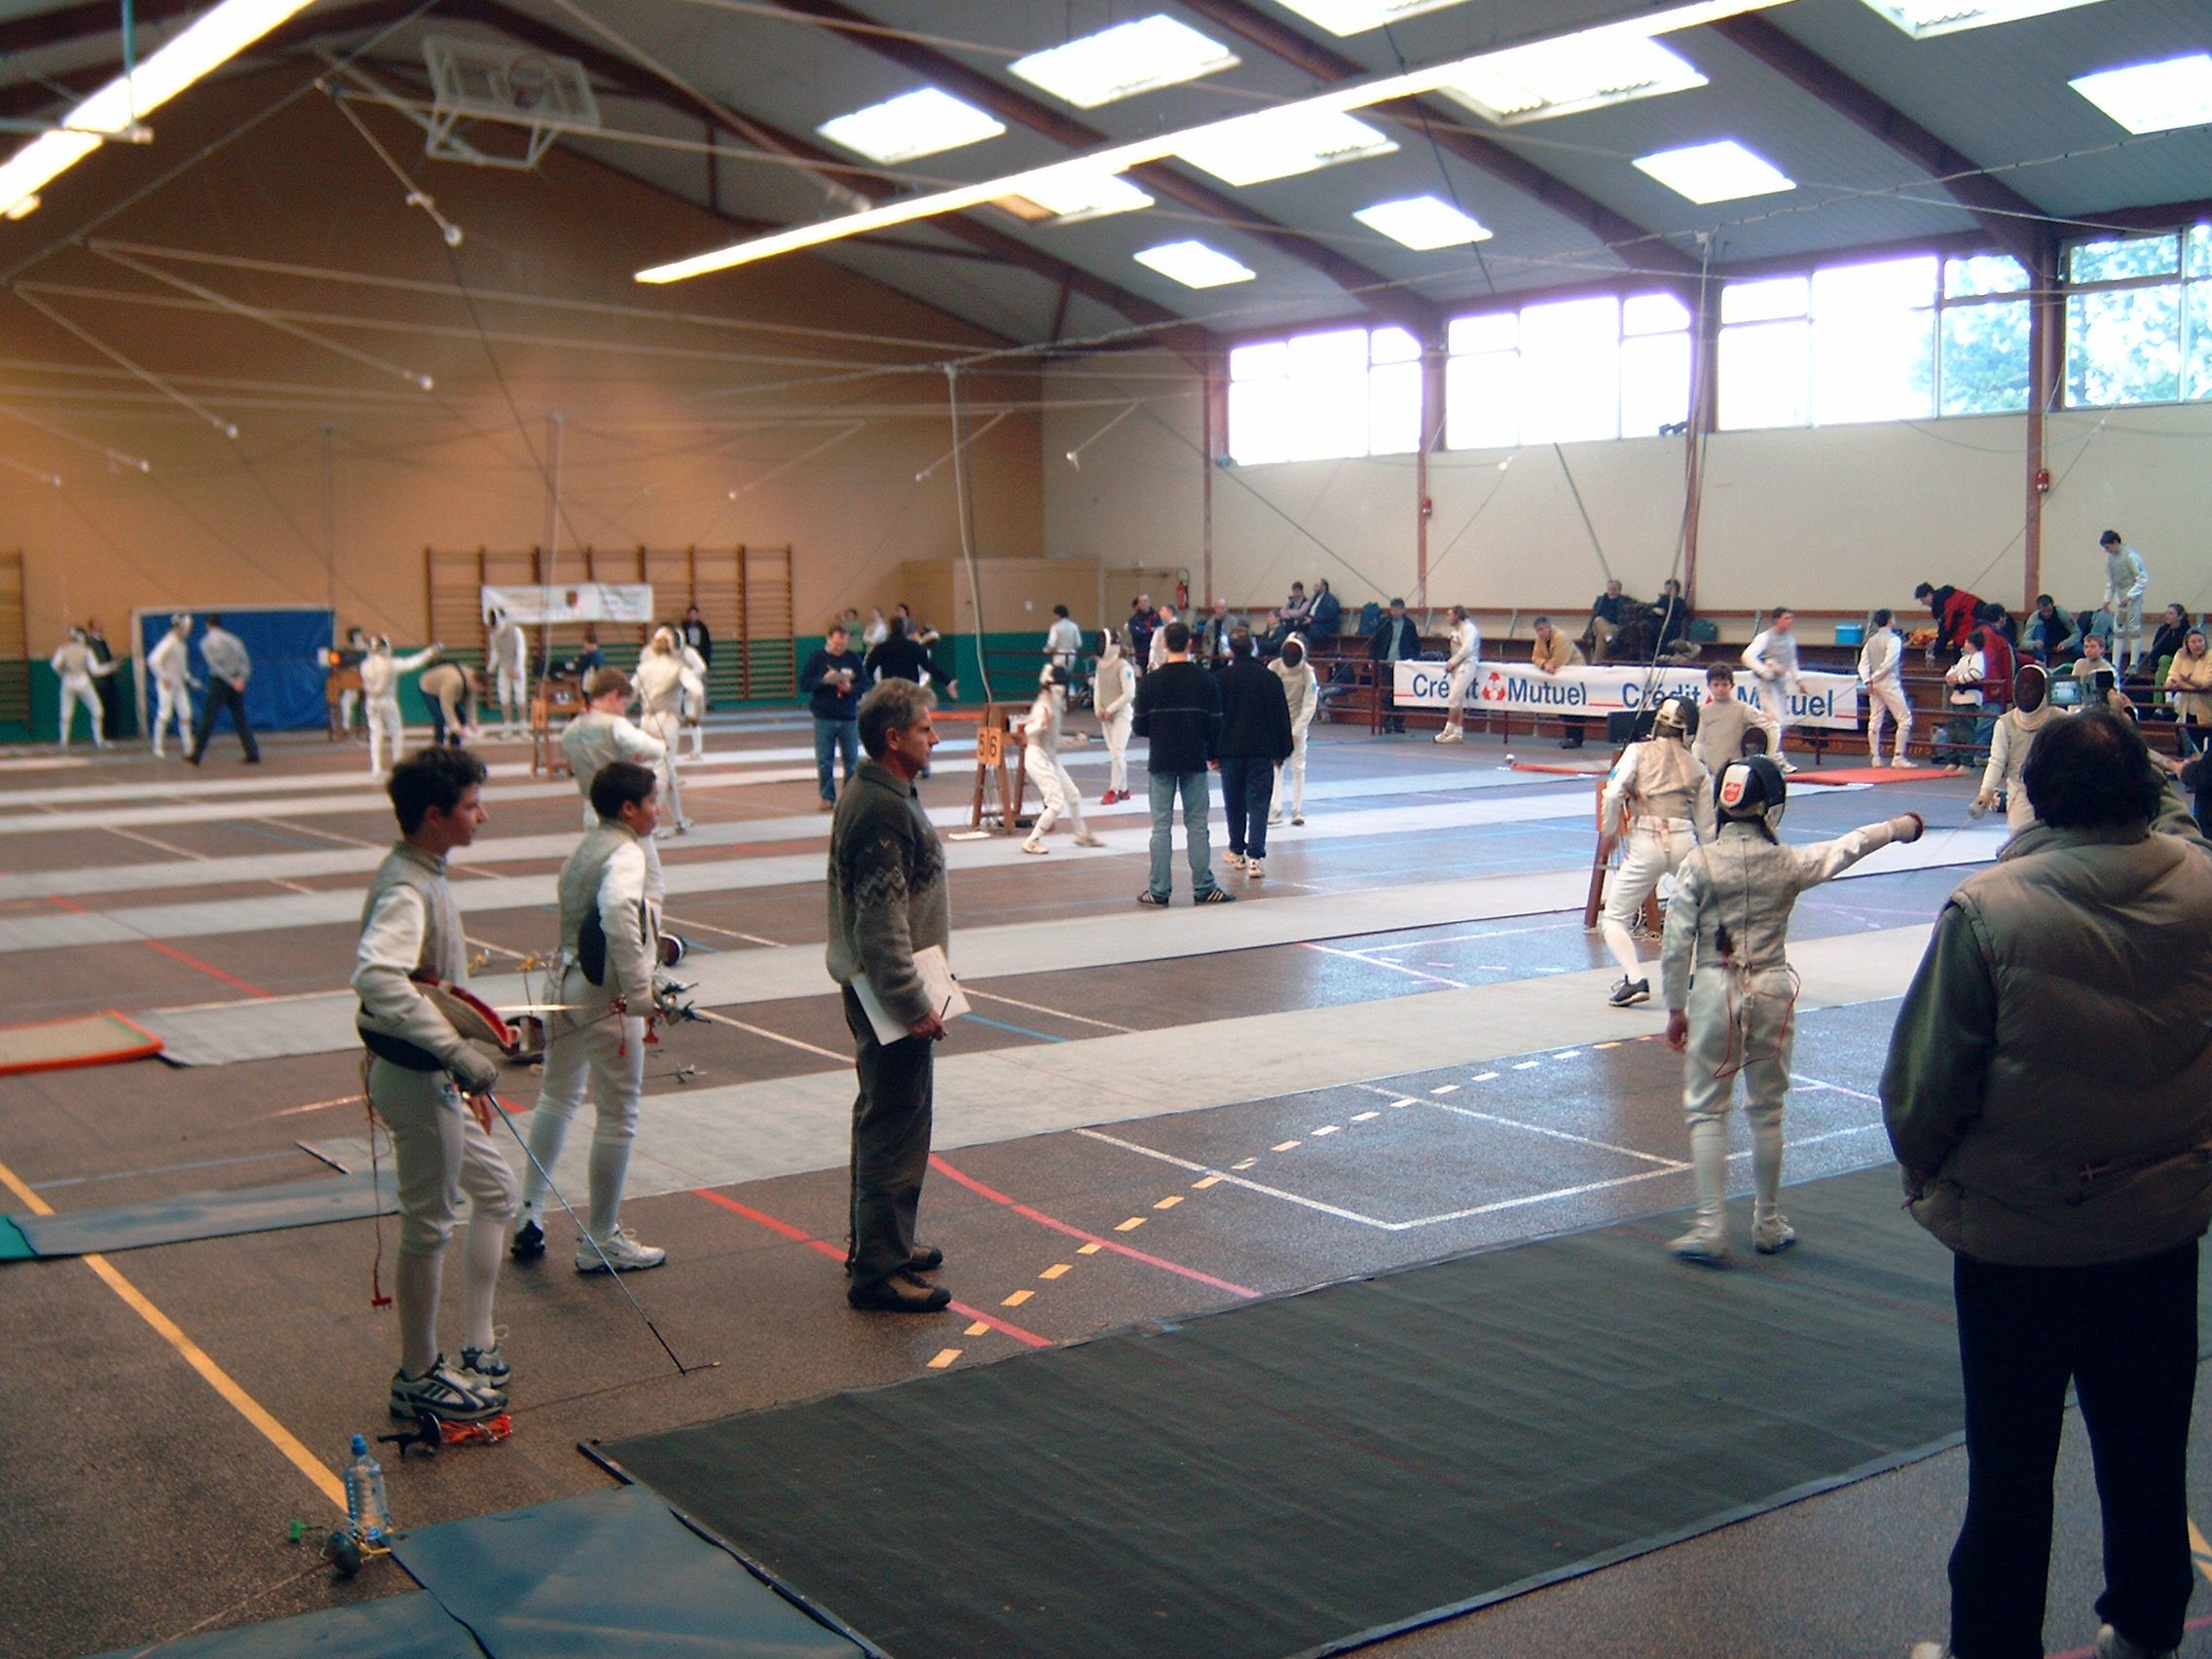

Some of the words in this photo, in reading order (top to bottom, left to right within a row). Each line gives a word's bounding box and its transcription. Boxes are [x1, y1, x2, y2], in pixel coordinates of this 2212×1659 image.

[1508, 678, 1587, 706] Mutuel
[1737, 685, 1833, 718] Muel
[989, 734, 997, 757] 6
